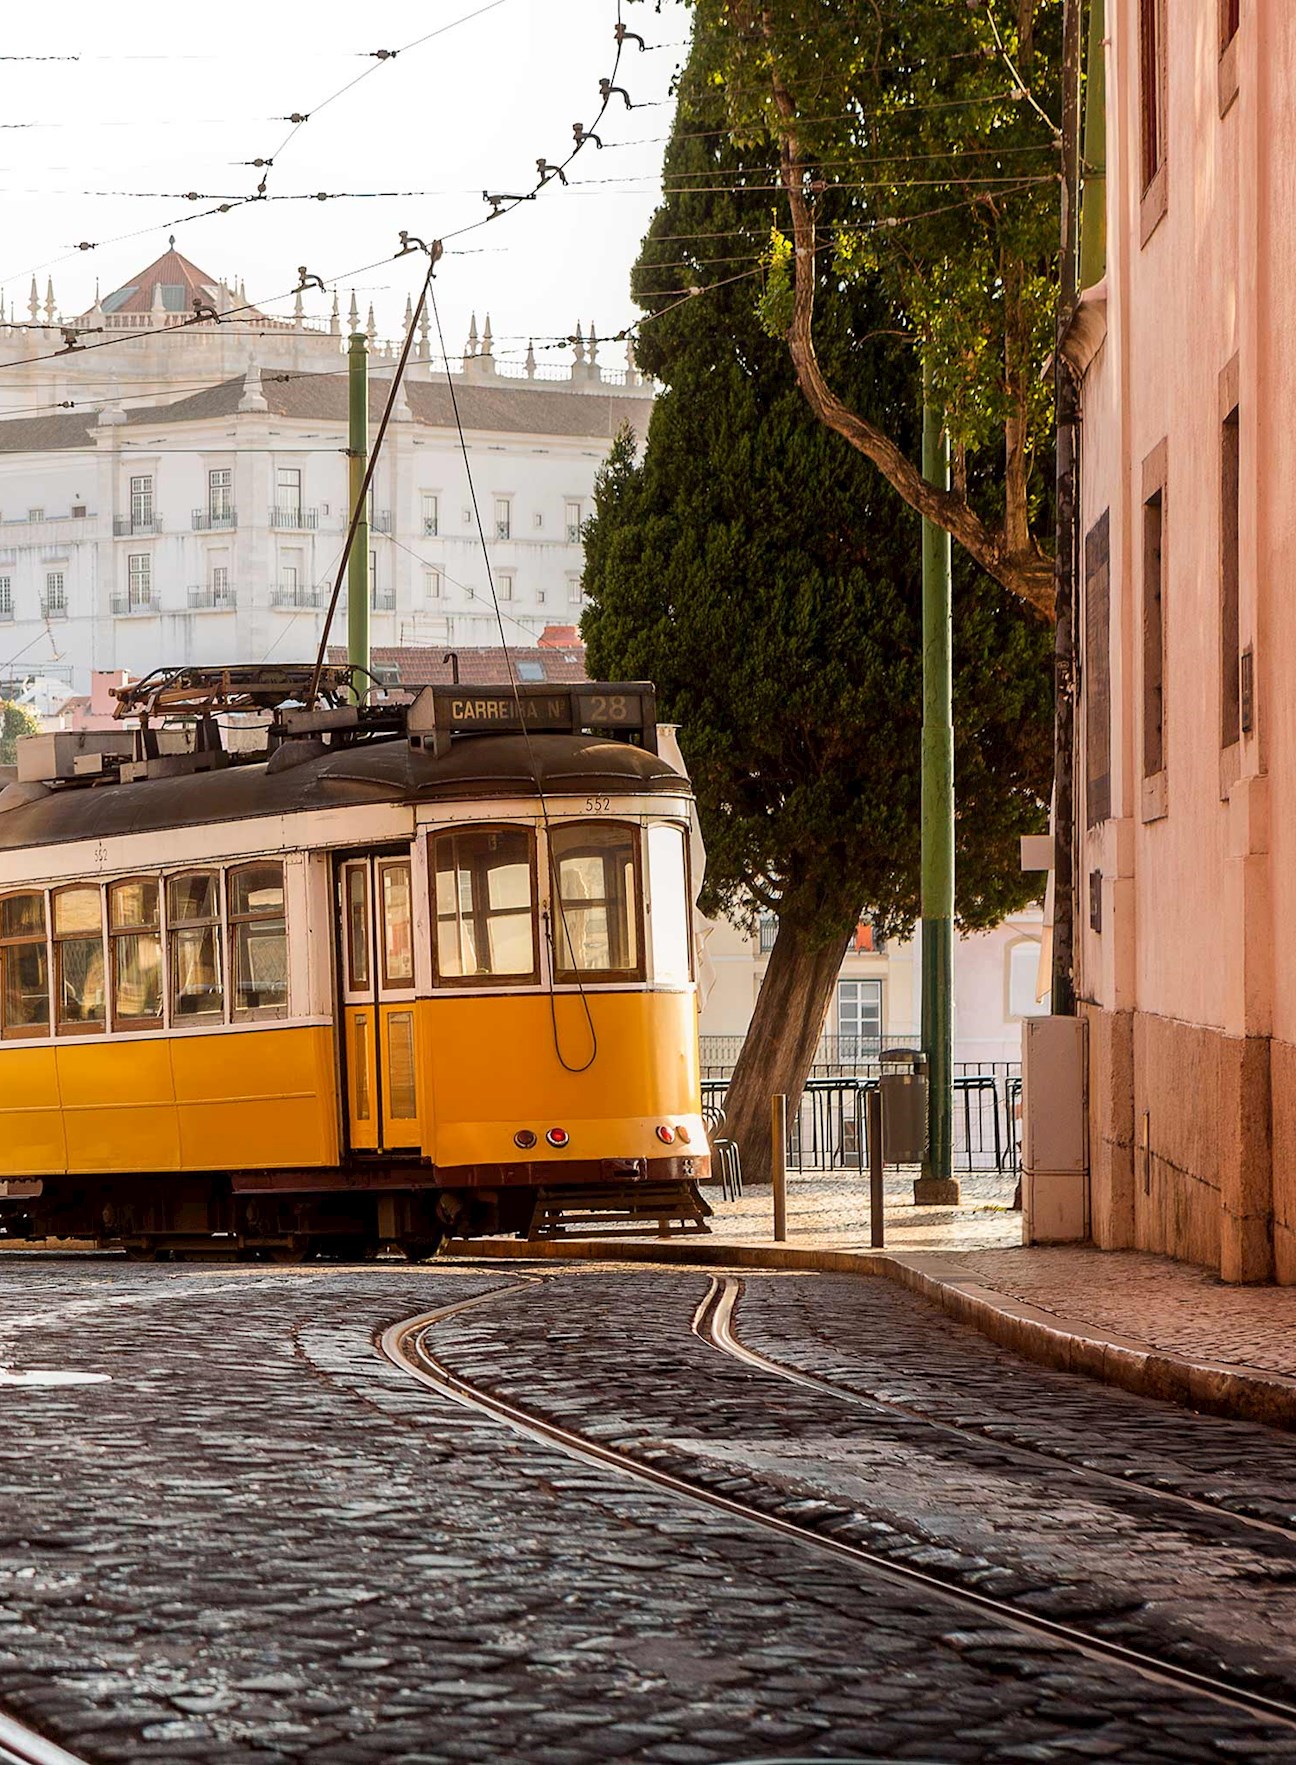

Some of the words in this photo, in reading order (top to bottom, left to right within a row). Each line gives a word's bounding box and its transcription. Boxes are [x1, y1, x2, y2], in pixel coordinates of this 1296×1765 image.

[451, 700, 538, 720] CARREIRA
[590, 695, 627, 721] 28
[585, 797, 610, 812] 552
